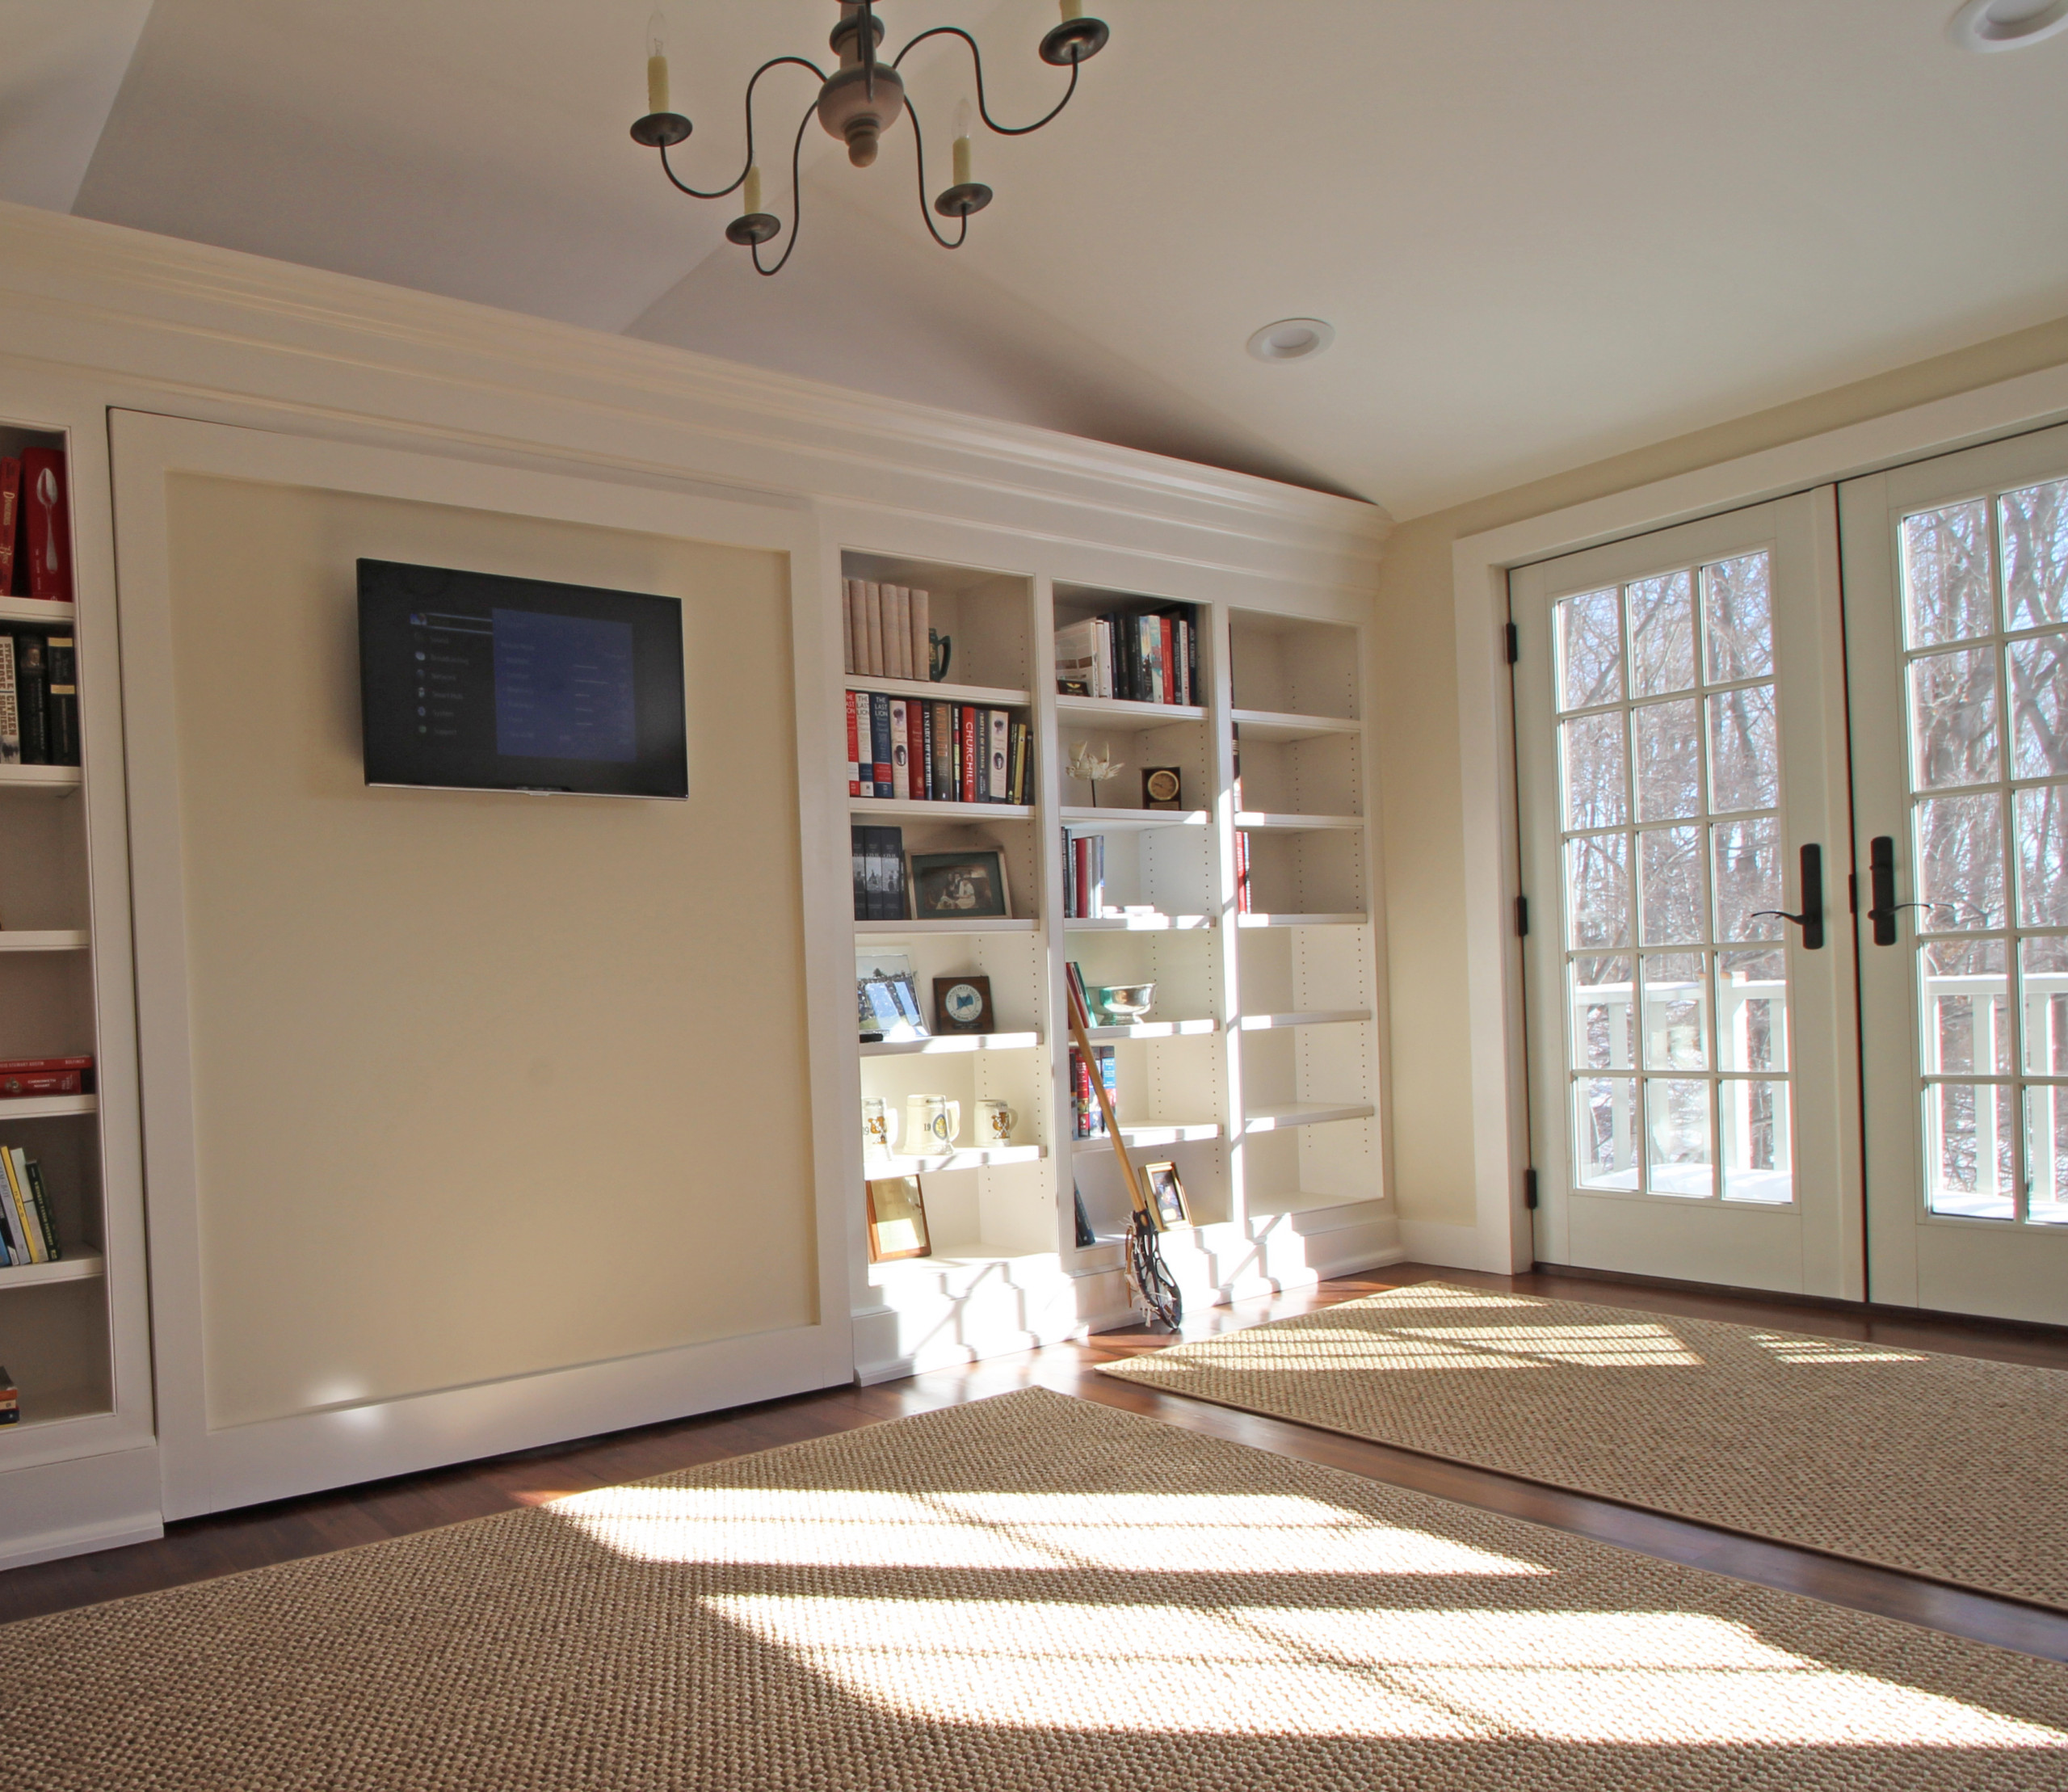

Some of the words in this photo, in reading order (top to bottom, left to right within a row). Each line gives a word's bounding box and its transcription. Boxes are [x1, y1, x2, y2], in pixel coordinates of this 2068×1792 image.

[4, 643, 14, 680] STEPHEN
[0, 695, 8, 736] SOLDIERS
[6, 695, 17, 736] CITIZEN
[856, 708, 870, 716] LION
[965, 721, 973, 785] CHURCHILL
[923, 1123, 931, 1131] 19
